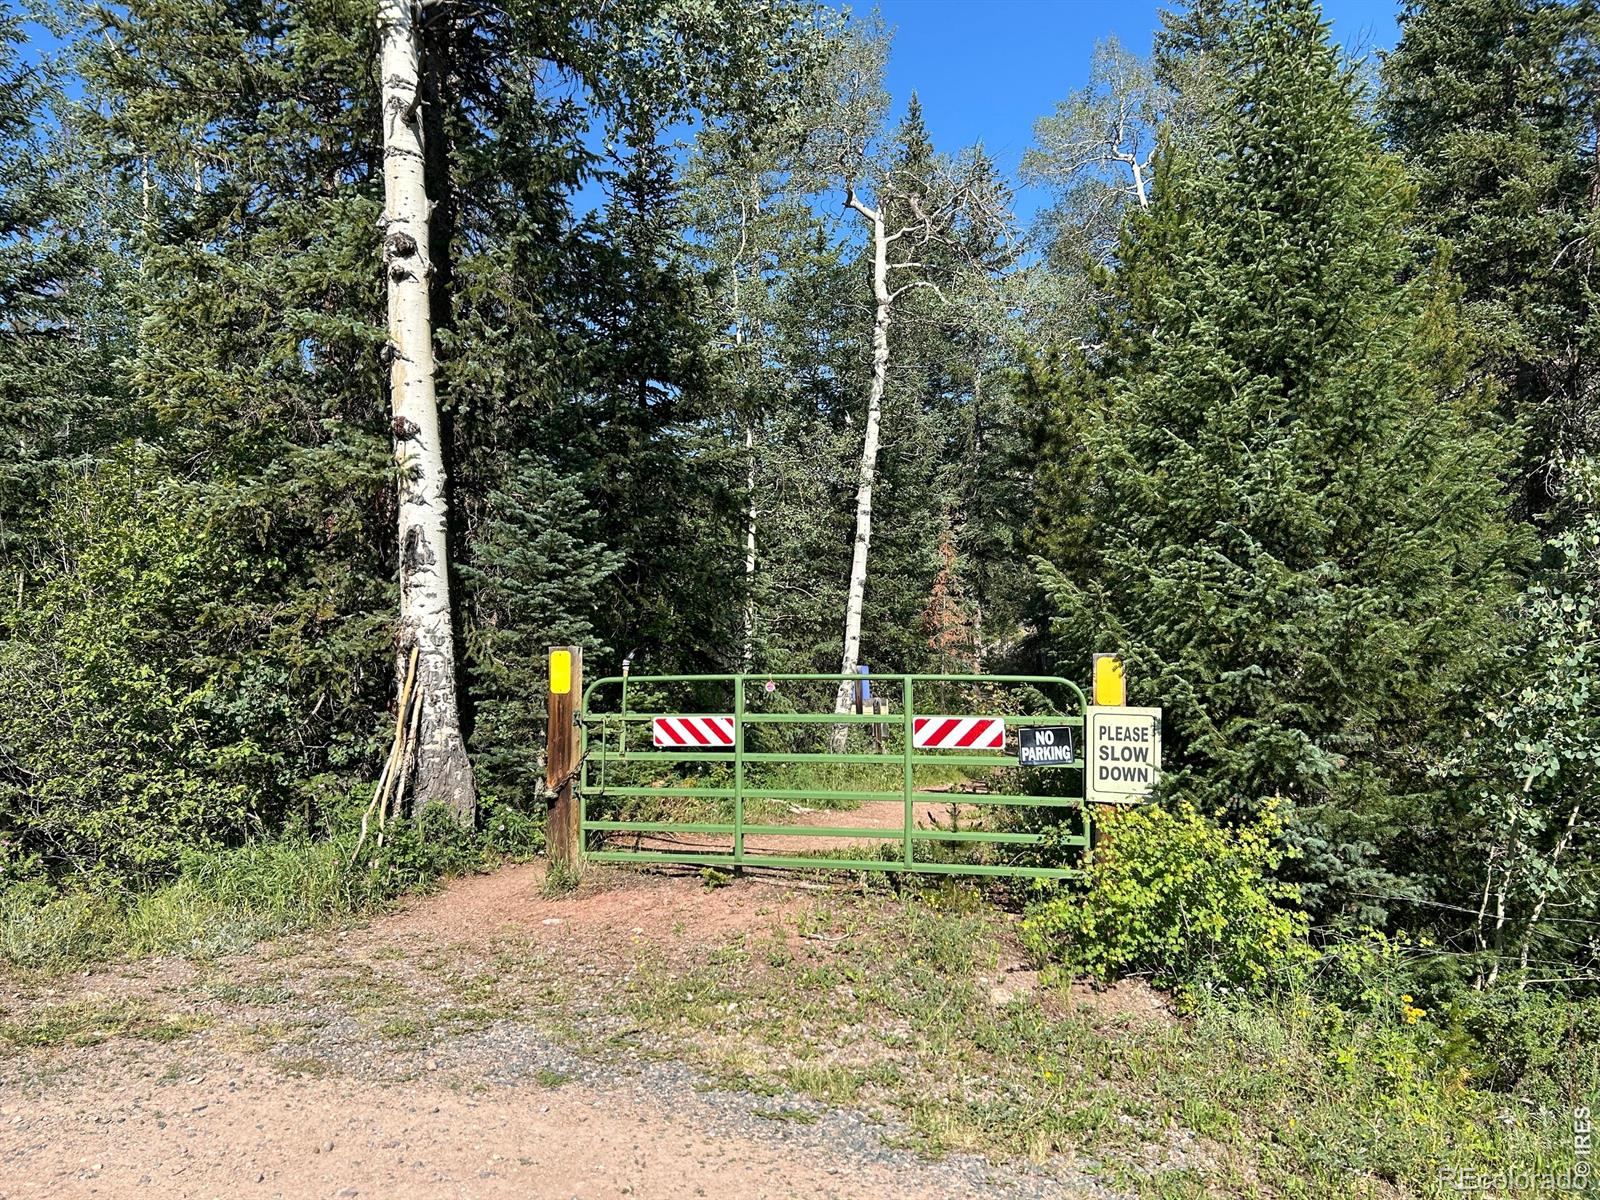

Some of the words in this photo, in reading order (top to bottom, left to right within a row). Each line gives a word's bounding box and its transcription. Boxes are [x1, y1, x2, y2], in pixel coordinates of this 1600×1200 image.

[1035, 730, 1054, 746] NO
[1099, 725, 1149, 742] PLEASE
[1021, 745, 1071, 762] PARKING
[1099, 745, 1149, 762] SLOW
[1099, 766, 1148, 782] DOWN
